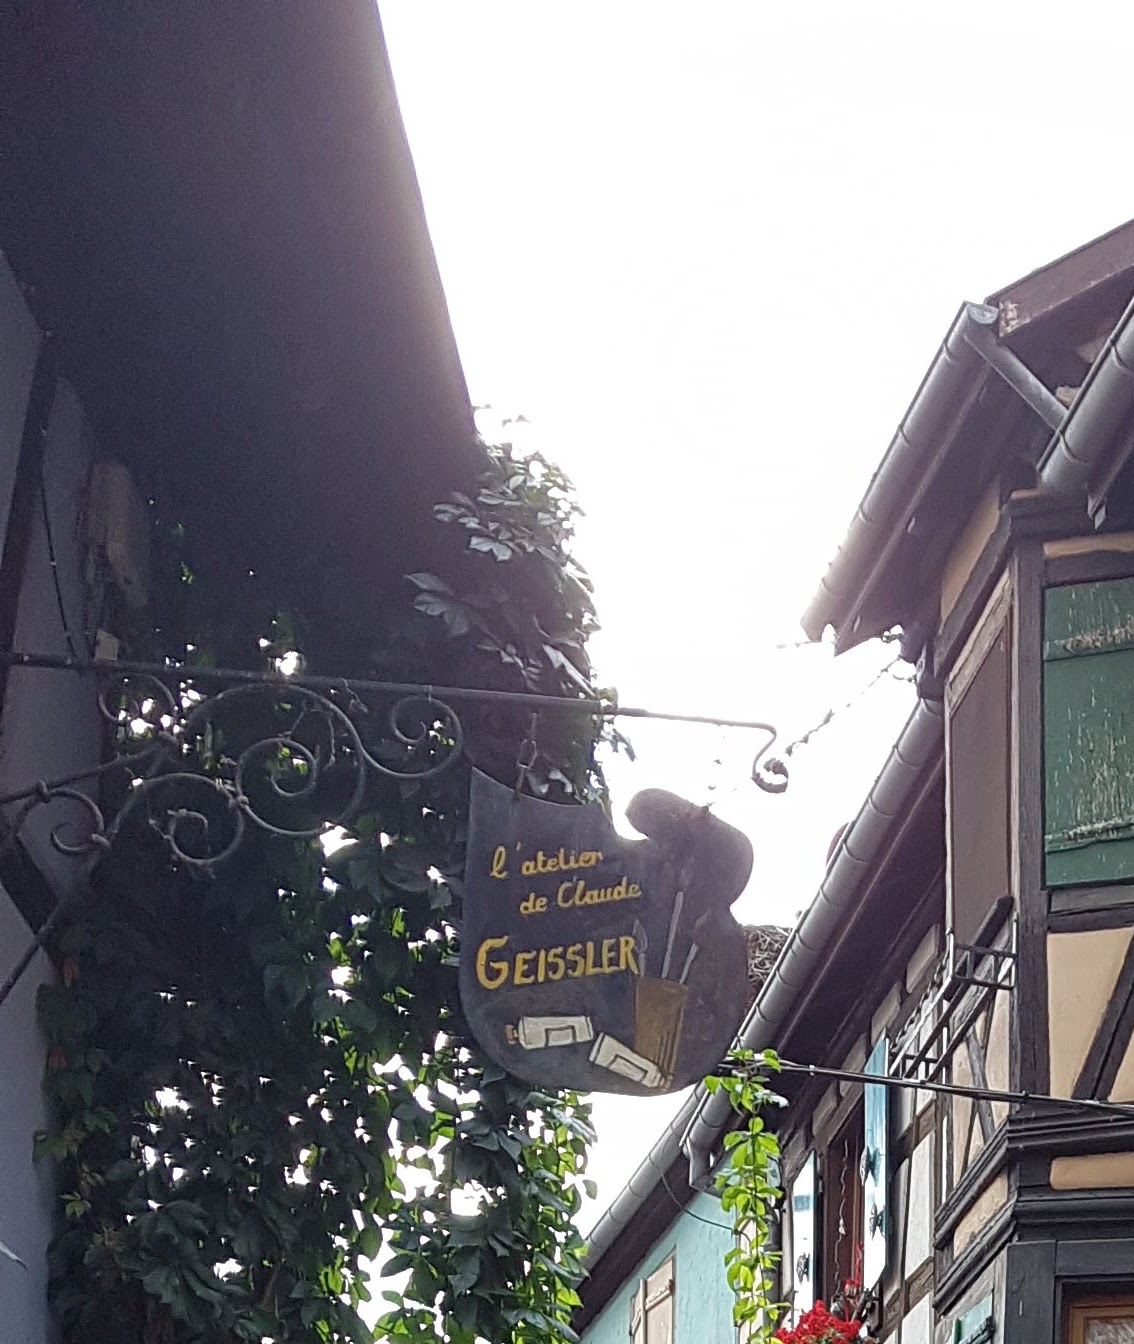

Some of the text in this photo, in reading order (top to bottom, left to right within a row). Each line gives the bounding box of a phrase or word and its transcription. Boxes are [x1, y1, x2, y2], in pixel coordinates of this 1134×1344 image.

[490, 841, 604, 879] l'atelier
[519, 876, 642, 914] de Claude
[476, 936, 639, 990] GEISSLER
